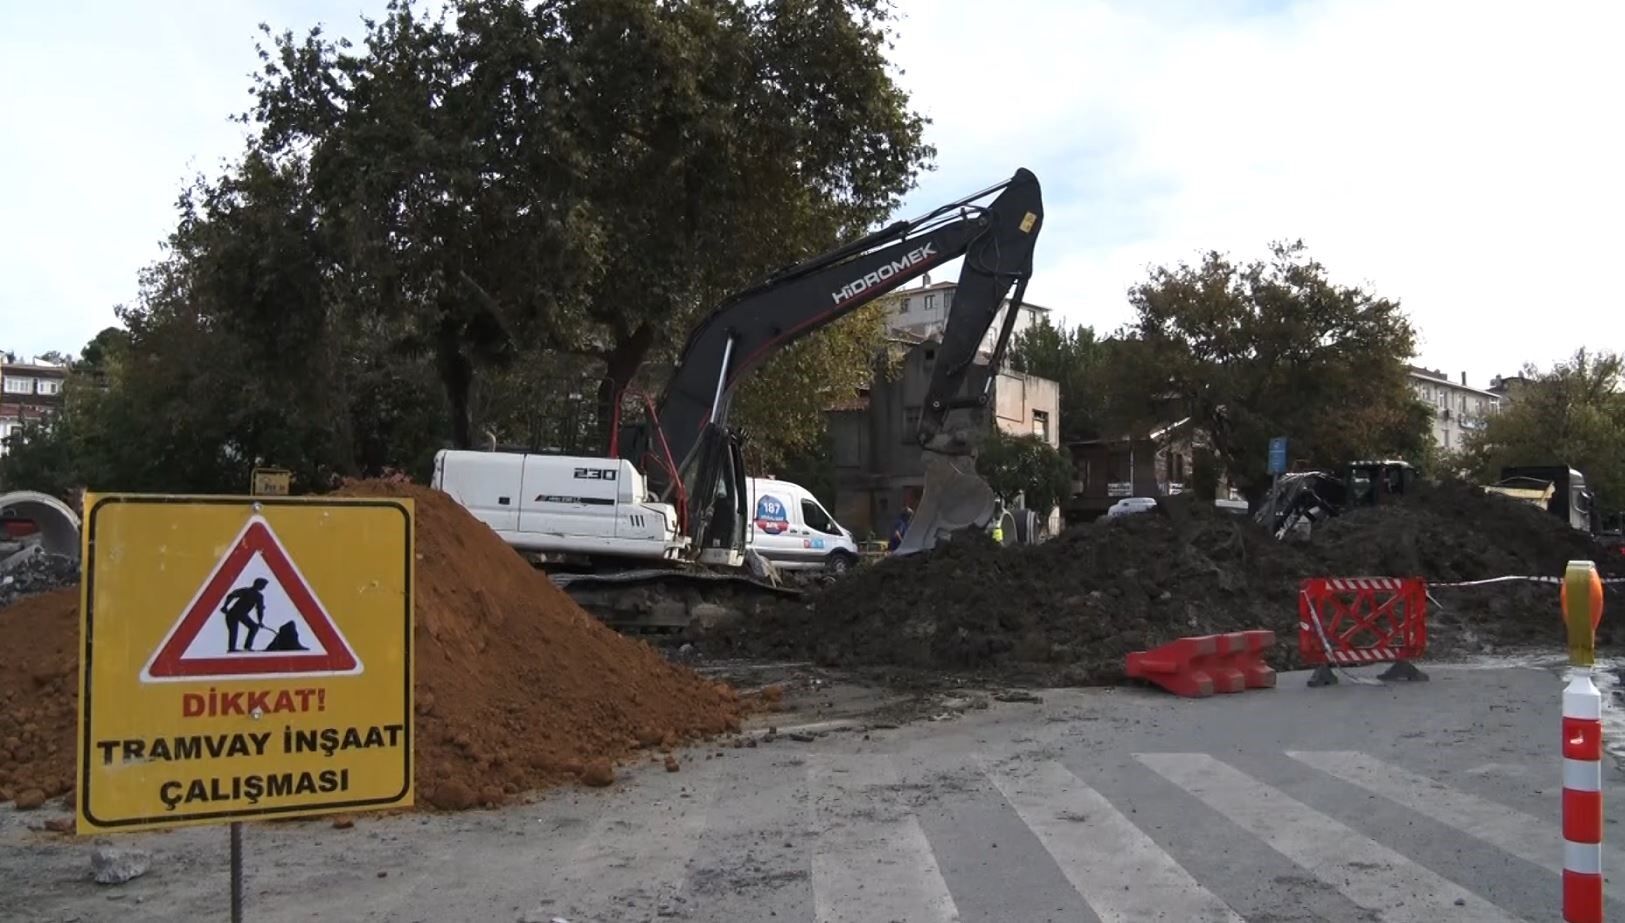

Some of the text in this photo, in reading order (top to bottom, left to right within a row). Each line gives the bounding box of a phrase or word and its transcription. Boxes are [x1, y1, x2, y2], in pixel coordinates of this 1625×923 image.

[574, 467, 617, 481] 230
[763, 502, 780, 515] 187
[182, 688, 326, 718] DİKKAT!
[97, 724, 403, 766] TRAMVAY İNŞAAT
[159, 769, 349, 809] ÇALIŞMASI
